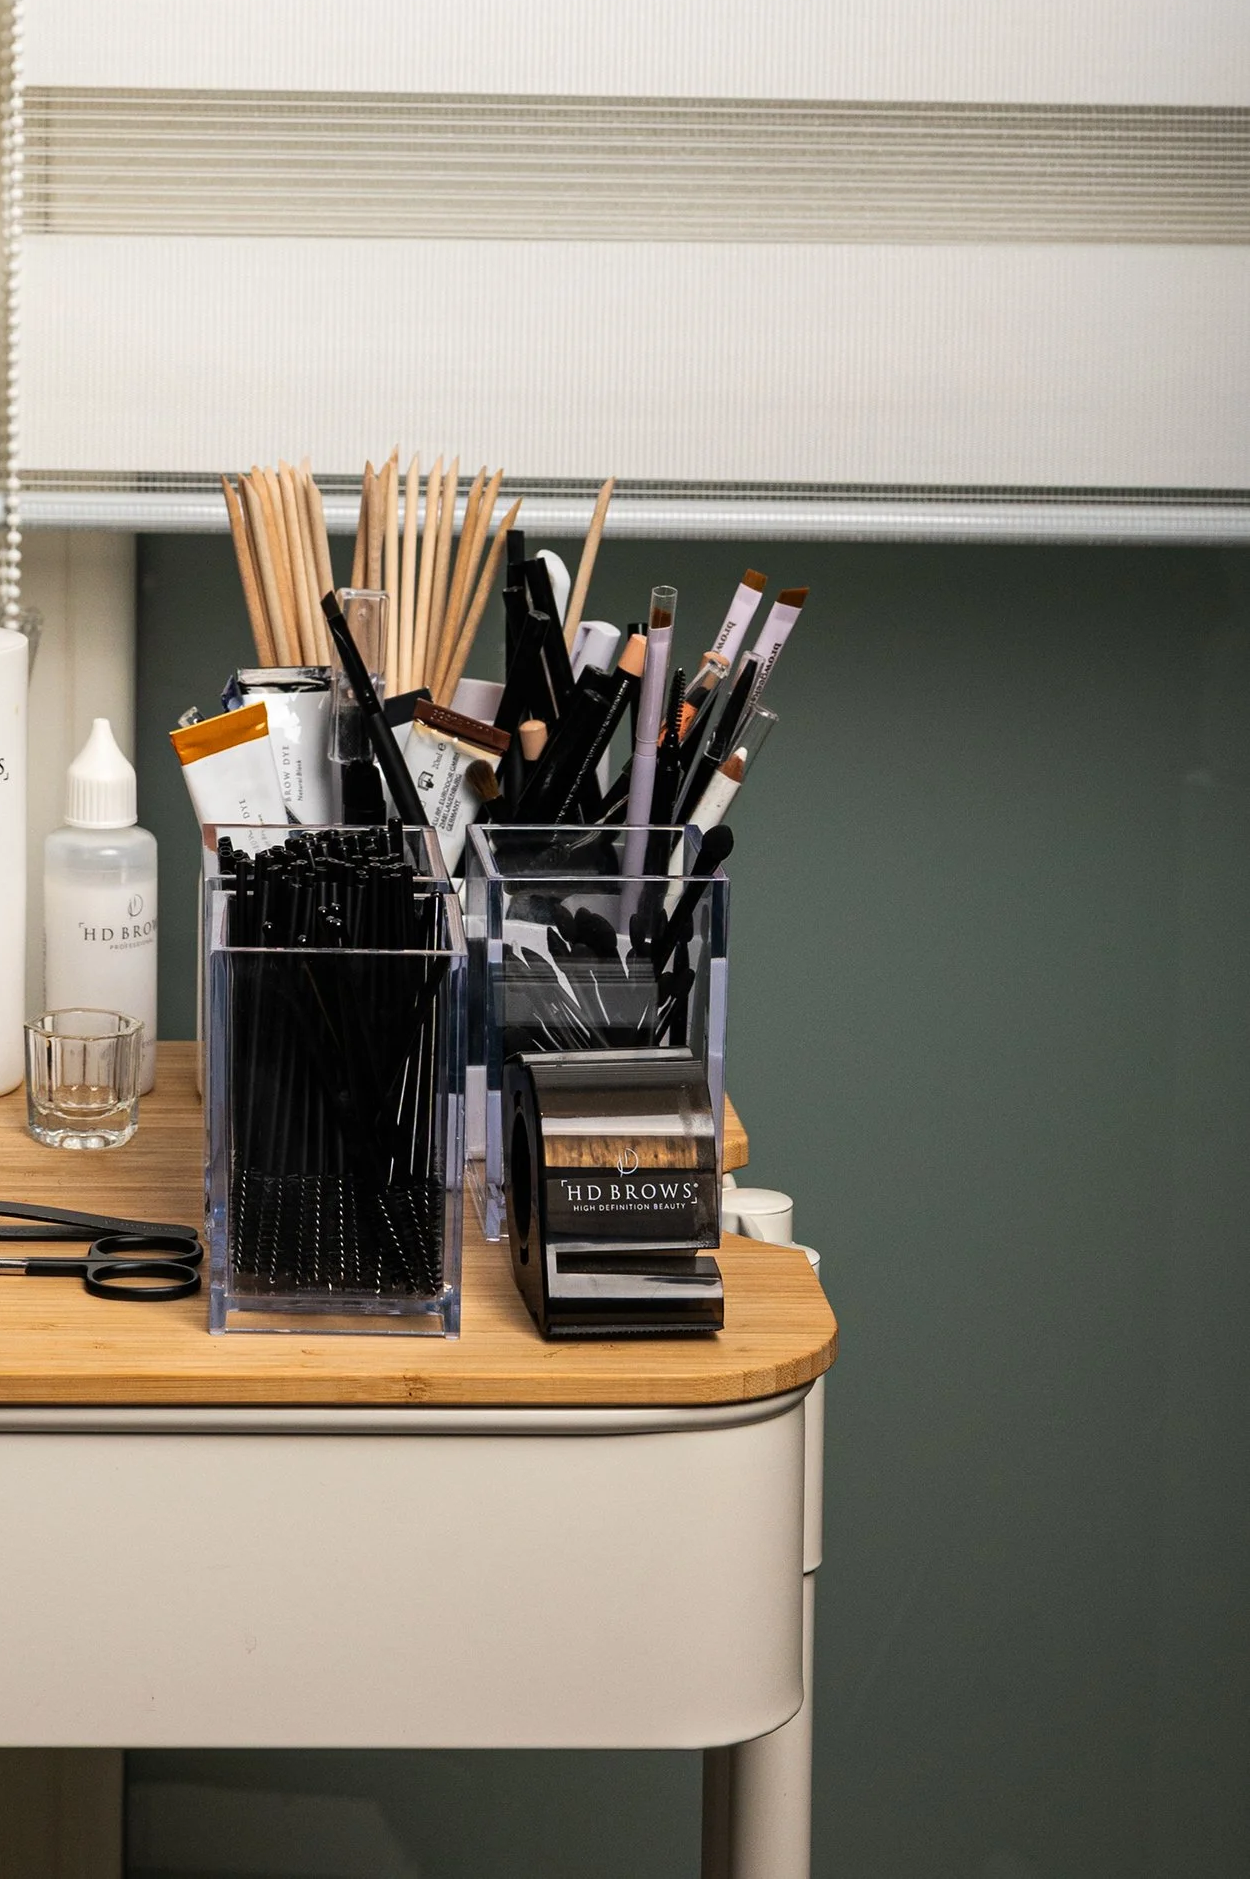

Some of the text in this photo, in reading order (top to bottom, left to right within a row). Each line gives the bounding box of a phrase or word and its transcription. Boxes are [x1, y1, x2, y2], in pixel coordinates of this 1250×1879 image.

[83, 927, 114, 941] HD
[567, 1182, 692, 1201] HD BROWS
[573, 1202, 686, 1212] HIGH DEFINITION BEAUTY
